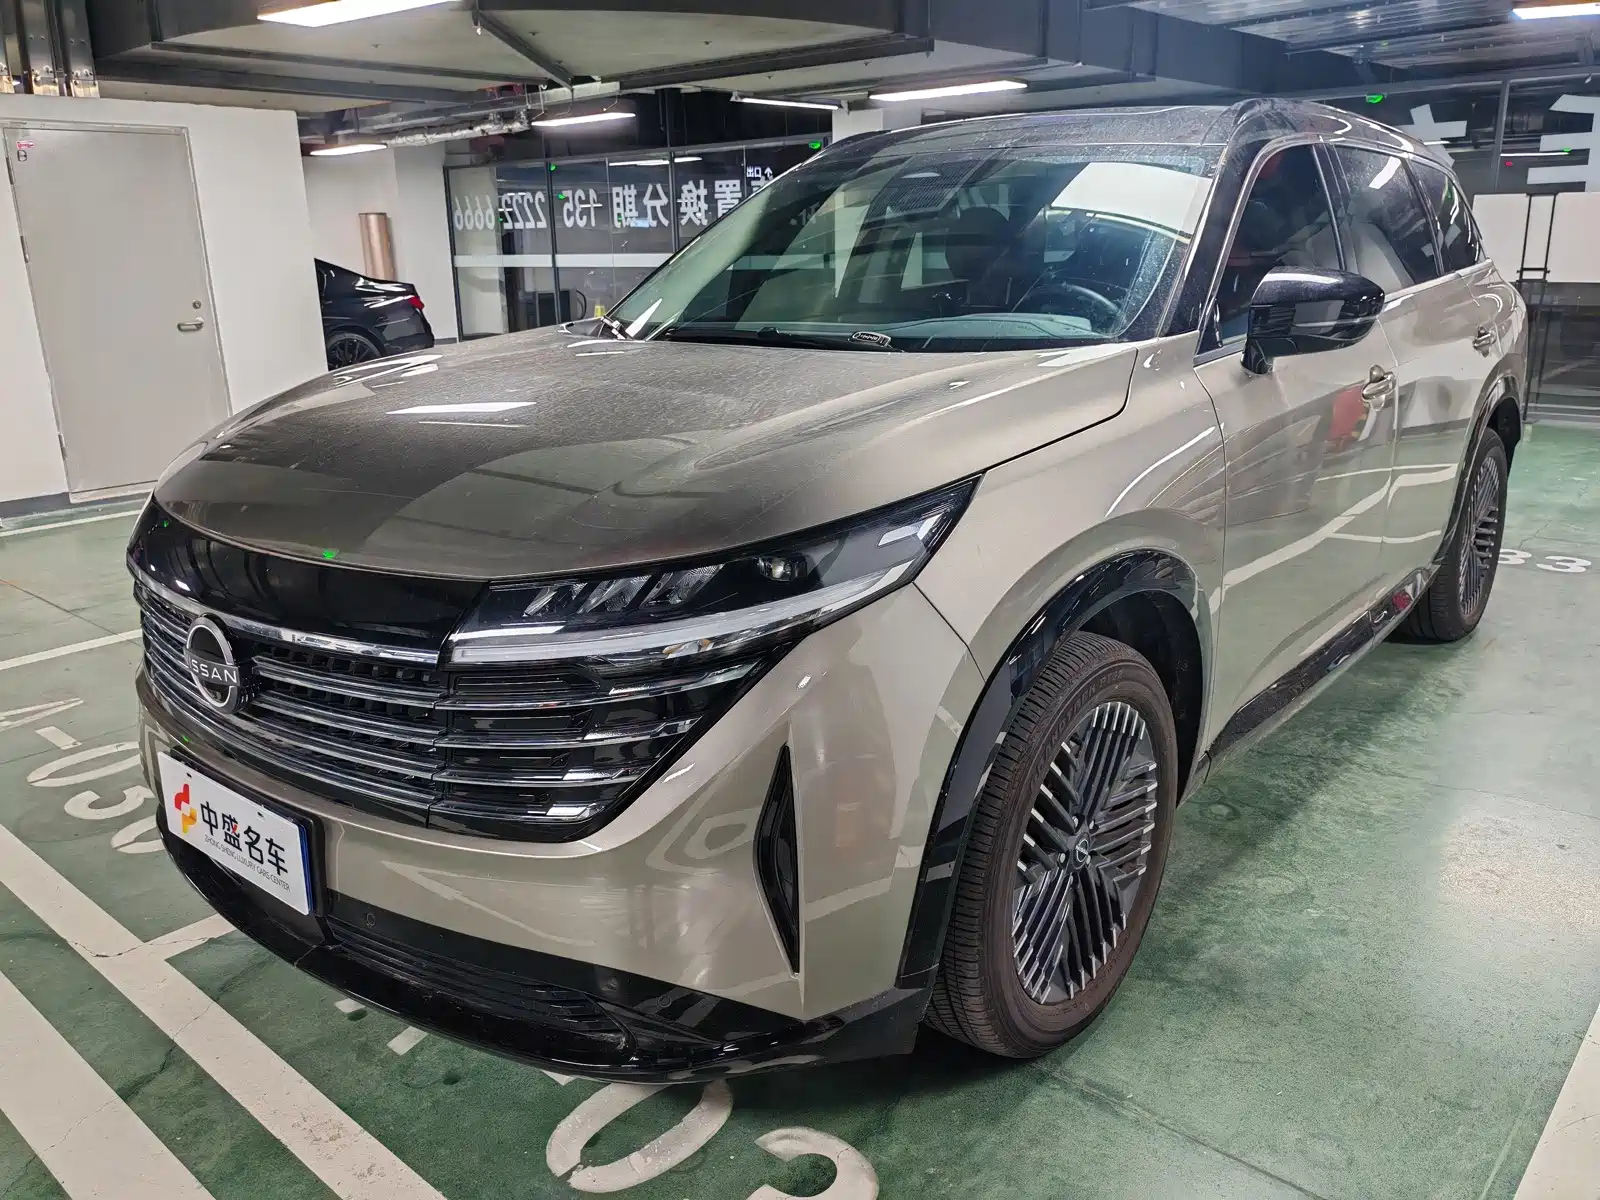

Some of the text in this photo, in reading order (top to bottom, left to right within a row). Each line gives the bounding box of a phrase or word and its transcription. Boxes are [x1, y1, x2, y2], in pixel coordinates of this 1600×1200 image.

[200, 801, 289, 876] 中盛名车
[204, 834, 291, 893] ZHONG SHENG LUXURY CARS CENTER
